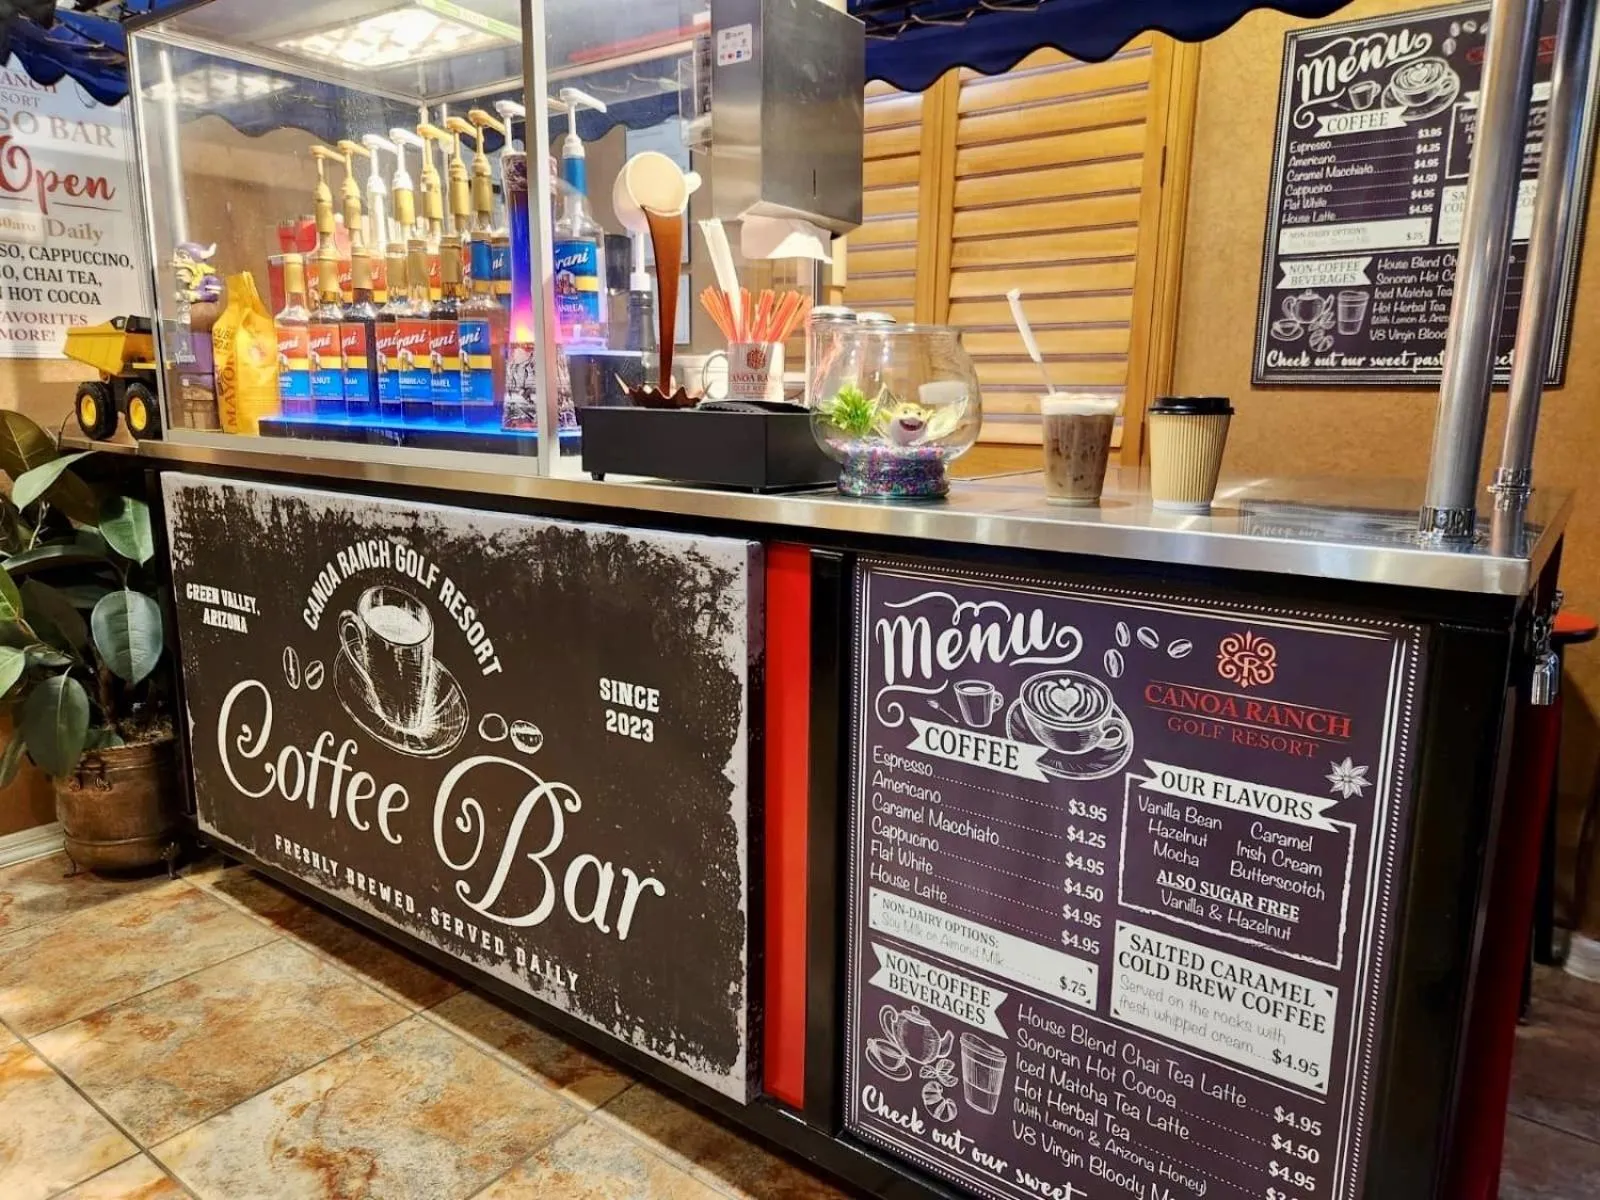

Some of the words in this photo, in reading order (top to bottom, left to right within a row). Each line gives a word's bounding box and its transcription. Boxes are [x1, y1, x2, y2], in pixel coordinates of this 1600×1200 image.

[1297, 28, 1432, 104] Menu
[48, 115, 116, 148] BAR
[1327, 111, 1388, 132] COFFEE
[1288, 154, 1336, 167] Americano
[1289, 141, 1332, 155] Espresso
[1286, 169, 1324, 182] Caramel
[1325, 163, 1374, 179] Macchiato
[1281, 211, 1310, 225] House
[1312, 210, 1337, 222] Latte
[1283, 199, 1301, 211] Flat
[1302, 198, 1328, 209] White
[46, 219, 104, 246] Daily
[23, 266, 63, 283] CHAI
[67, 269, 102, 287] TEA,
[29, 245, 134, 270] CAPPUCCINO,
[555, 247, 589, 270] rani
[1289, 260, 1361, 275] NON-COFFEE
[1377, 258, 1408, 270] House
[1420, 270, 1438, 282] Hot
[8, 286, 43, 302] HOT
[47, 289, 102, 305] COCOA
[1291, 273, 1357, 286] BEVERAGES
[1396, 286, 1433, 299] Matcha
[1373, 302, 1391, 314] Hot
[1429, 300, 1446, 311] Tea
[1418, 328, 1449, 340] Blood
[1266, 350, 1309, 368] Check
[1314, 352, 1343, 367] out
[1341, 353, 1367, 367] our
[1370, 350, 1417, 367] sweet
[186, 582, 221, 605] GREEN
[303, 562, 342, 632] CANOA
[337, 539, 391, 582] RANCH
[394, 544, 440, 590] GOLF
[438, 576, 503, 680] RESORT
[203, 607, 248, 634] ARIZONA
[875, 593, 1083, 687] Menu
[600, 676, 660, 713] SINCE
[1144, 683, 1238, 718] CANOA
[1246, 702, 1353, 738] RANCH
[605, 709, 655, 743] 2023
[1167, 716, 1225, 739] GOLF
[1231, 729, 1320, 758] RESORT
[217, 679, 410, 844] Coffee
[924, 726, 1019, 771] COFFEE
[872, 745, 934, 777] Espresso
[1068, 799, 1107, 822] $3.95
[1161, 770, 1205, 797] OUR
[1213, 783, 1313, 820] FLAVORS
[872, 770, 942, 804] Americano
[1066, 825, 1106, 849] $4.25
[1138, 795, 1181, 821] Vanilla
[1185, 806, 1222, 831] Bean
[433, 755, 666, 941] Bar
[872, 792, 925, 823] Caramel
[928, 808, 1000, 846] Macchiato
[1064, 852, 1105, 876] $4.95
[1149, 818, 1208, 848] Hazelnut
[1153, 841, 1200, 867] Mocha
[1250, 821, 1313, 853] Caramel
[871, 815, 940, 852] Cappucino
[1063, 877, 1104, 902] $4.50
[1236, 840, 1266, 864] Irish
[1272, 848, 1323, 878] Cream
[870, 839, 895, 861] Flat
[898, 847, 934, 876] White
[1062, 904, 1102, 929] $4.95
[1157, 869, 1197, 892] ALSO
[1199, 880, 1253, 908] SUGAR
[1257, 896, 1300, 923] FREE
[1230, 860, 1326, 901] Butterscotch
[275, 833, 339, 877] FRESHLY
[431, 907, 505, 956] SERVED
[516, 945, 579, 992] DAILY
[869, 863, 910, 891] House
[914, 877, 948, 905] Latte
[1060, 930, 1100, 955] $4.95
[882, 898, 942, 927] NON-DAIRY
[944, 920, 999, 949] OPTIONS:
[1161, 889, 1204, 917] Vanilla
[1208, 903, 1223, 922] &
[1227, 908, 1292, 941] Hazelnut
[885, 953, 991, 1008] NON-COFFEE
[1059, 975, 1087, 998] $.75
[1130, 933, 1205, 972] SALTED
[1210, 959, 1316, 1008] CARAMEL
[889, 972, 986, 1025] BEVERAGES
[1118, 951, 1170, 981] COLD
[1176, 970, 1237, 1002] BREW
[1242, 991, 1327, 1034] COFFEE
[1120, 974, 1164, 1003] Served
[1168, 995, 1184, 1009] on
[1189, 999, 1210, 1019] the
[1213, 1009, 1251, 1033] rocks
[1256, 1023, 1286, 1045] with
[1119, 994, 1149, 1017] fresh
[1153, 1009, 1206, 1038] whipped
[1211, 1030, 1254, 1054] cream
[1272, 1048, 1320, 1078] $4.95
[1017, 1003, 1067, 1039] House
[1070, 1023, 1116, 1057] Blend
[1122, 1043, 1160, 1075] Chai
[1166, 1059, 1195, 1089] Tea
[1200, 1073, 1248, 1109] Latte
[1273, 1105, 1322, 1136] $4.95
[1014, 1076, 1042, 1103] Hot
[1047, 1090, 1099, 1128] Herbal
[1104, 1112, 1131, 1143] Tea
[1016, 1027, 1081, 1070] Sonoran
[1086, 1055, 1116, 1083] Hot
[1122, 1069, 1177, 1109] Cocoa
[1271, 1133, 1320, 1164] $4.50
[862, 1084, 926, 1136] Check
[931, 1128, 975, 1155] out
[972, 1146, 1008, 1175] our
[1016, 1167, 1088, 1200] sweet
[1016, 1051, 1045, 1081] Iced
[1050, 1065, 1108, 1107] Matcha
[1114, 1091, 1141, 1121] Tea
[1146, 1105, 1190, 1140] Latte
[1268, 1160, 1316, 1192] $4.95
[1012, 1119, 1038, 1147] V8
[1041, 1132, 1084, 1171] Virgin
[1089, 1155, 1146, 1200] Bloody
[1013, 1099, 1042, 1124] (With
[1045, 1110, 1084, 1141] Lemon
[1087, 1131, 1101, 1147] &
[1104, 1138, 1155, 1173] Arizona
[1159, 1160, 1207, 1197] Honey)
